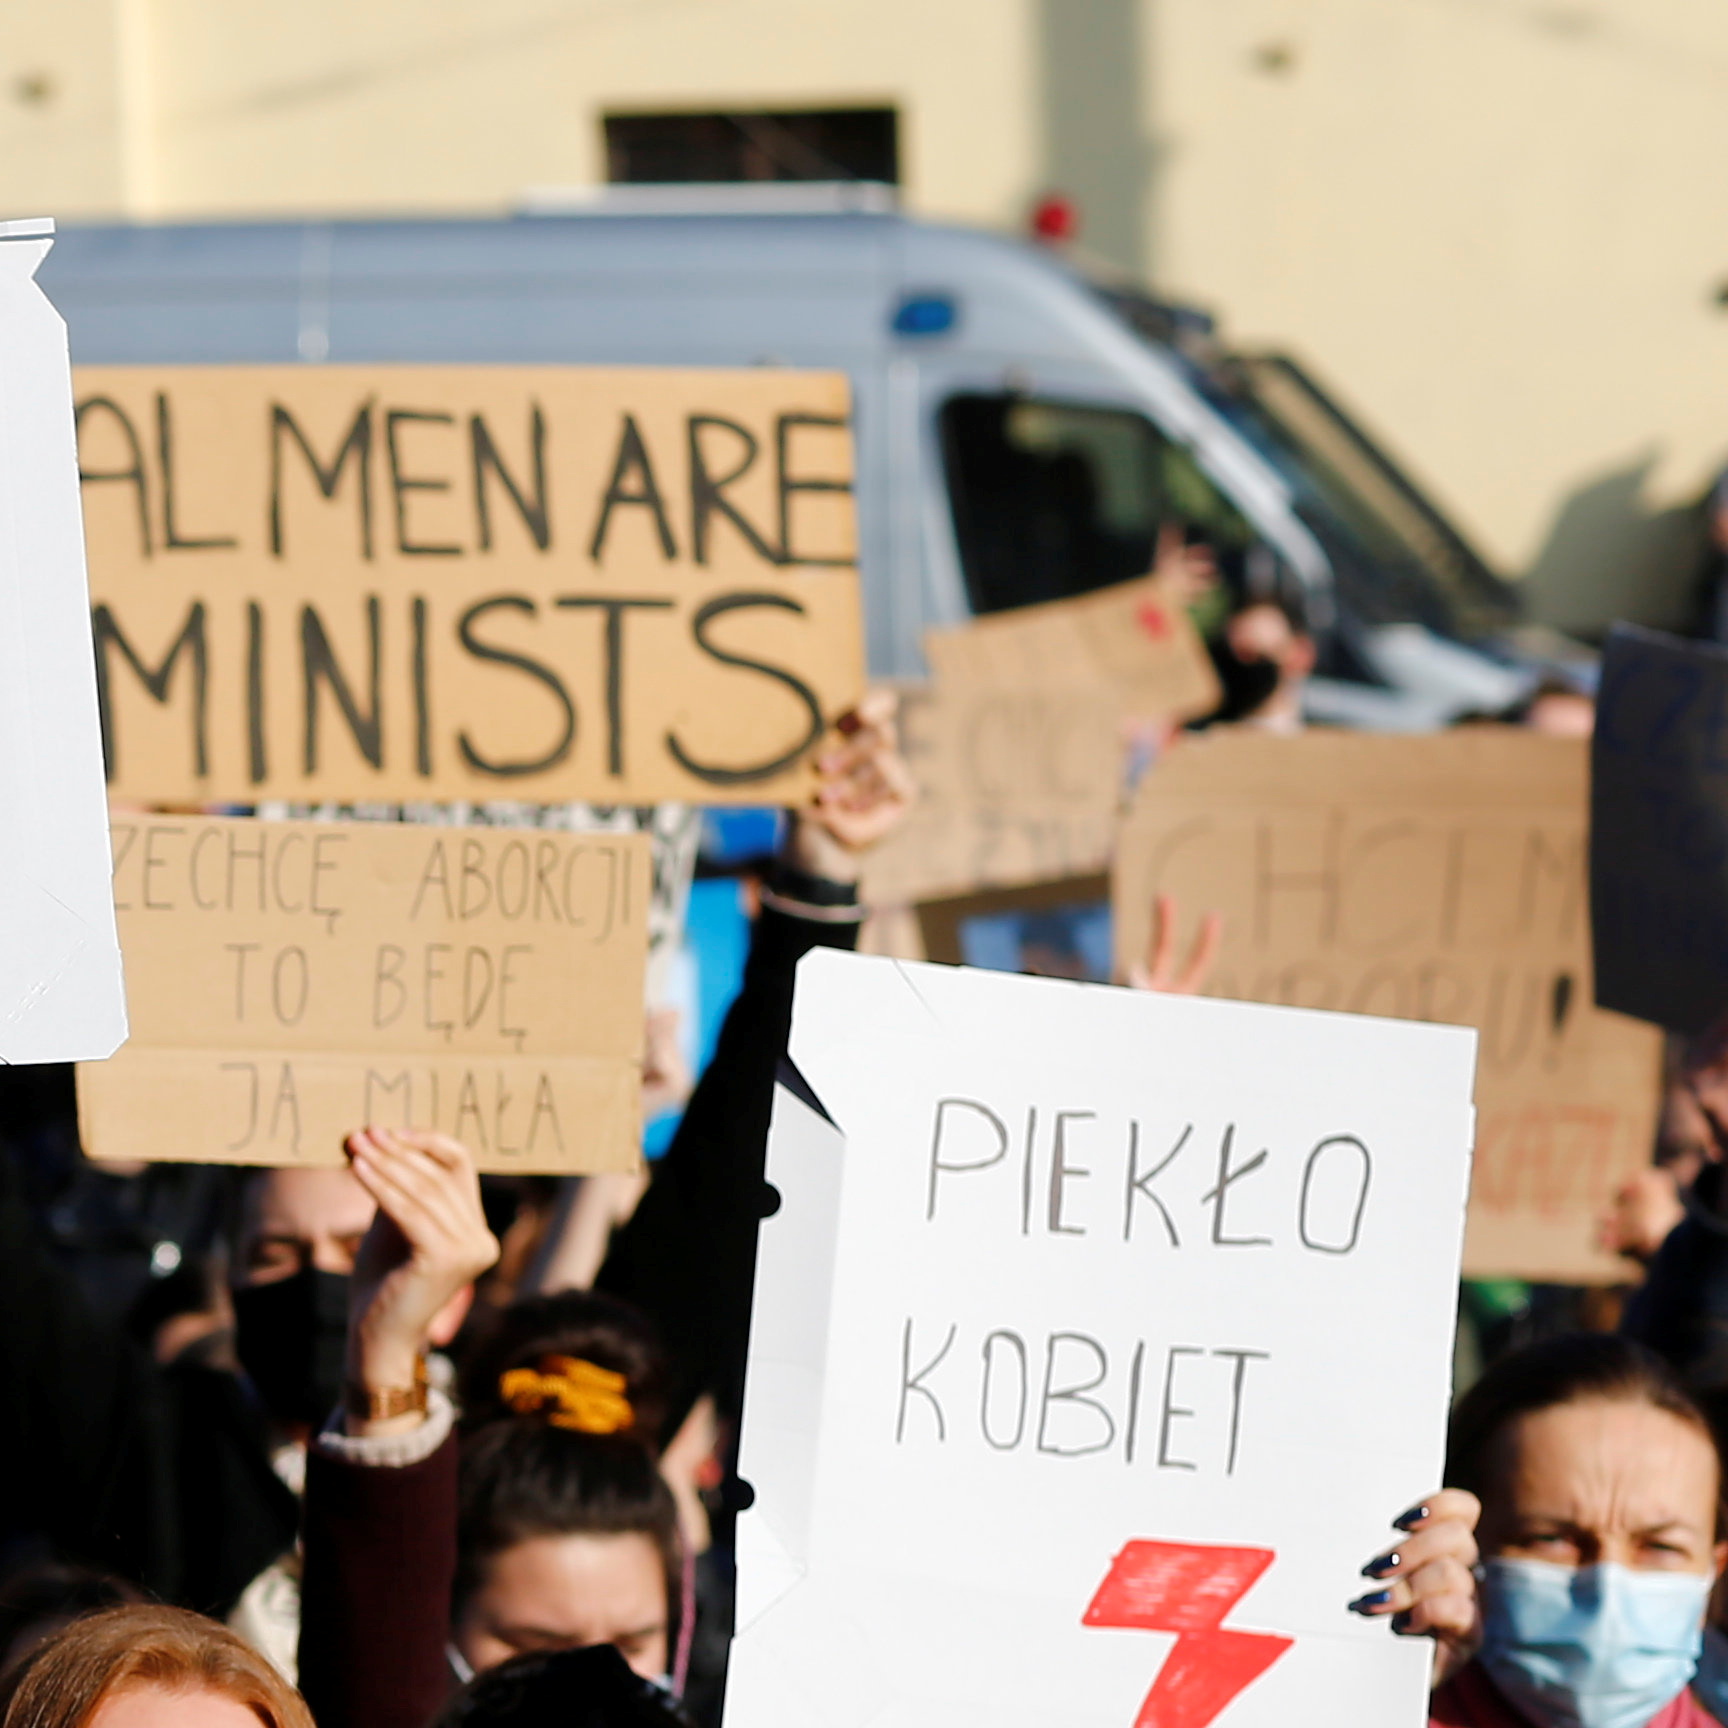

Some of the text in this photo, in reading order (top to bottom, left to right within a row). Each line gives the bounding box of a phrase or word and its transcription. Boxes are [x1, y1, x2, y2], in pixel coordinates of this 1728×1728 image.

[268, 392, 554, 562] MEN
[587, 408, 860, 570] ARE
[92, 589, 827, 787] MINISTS
[409, 837, 635, 945] ABORCJI
[224, 941, 535, 1050] TO BĘDĘ
[218, 1059, 566, 1156] JĄ MIAŁA
[924, 1096, 1374, 1255] PIEKŁO
[894, 1315, 1272, 1478] KOBIET
